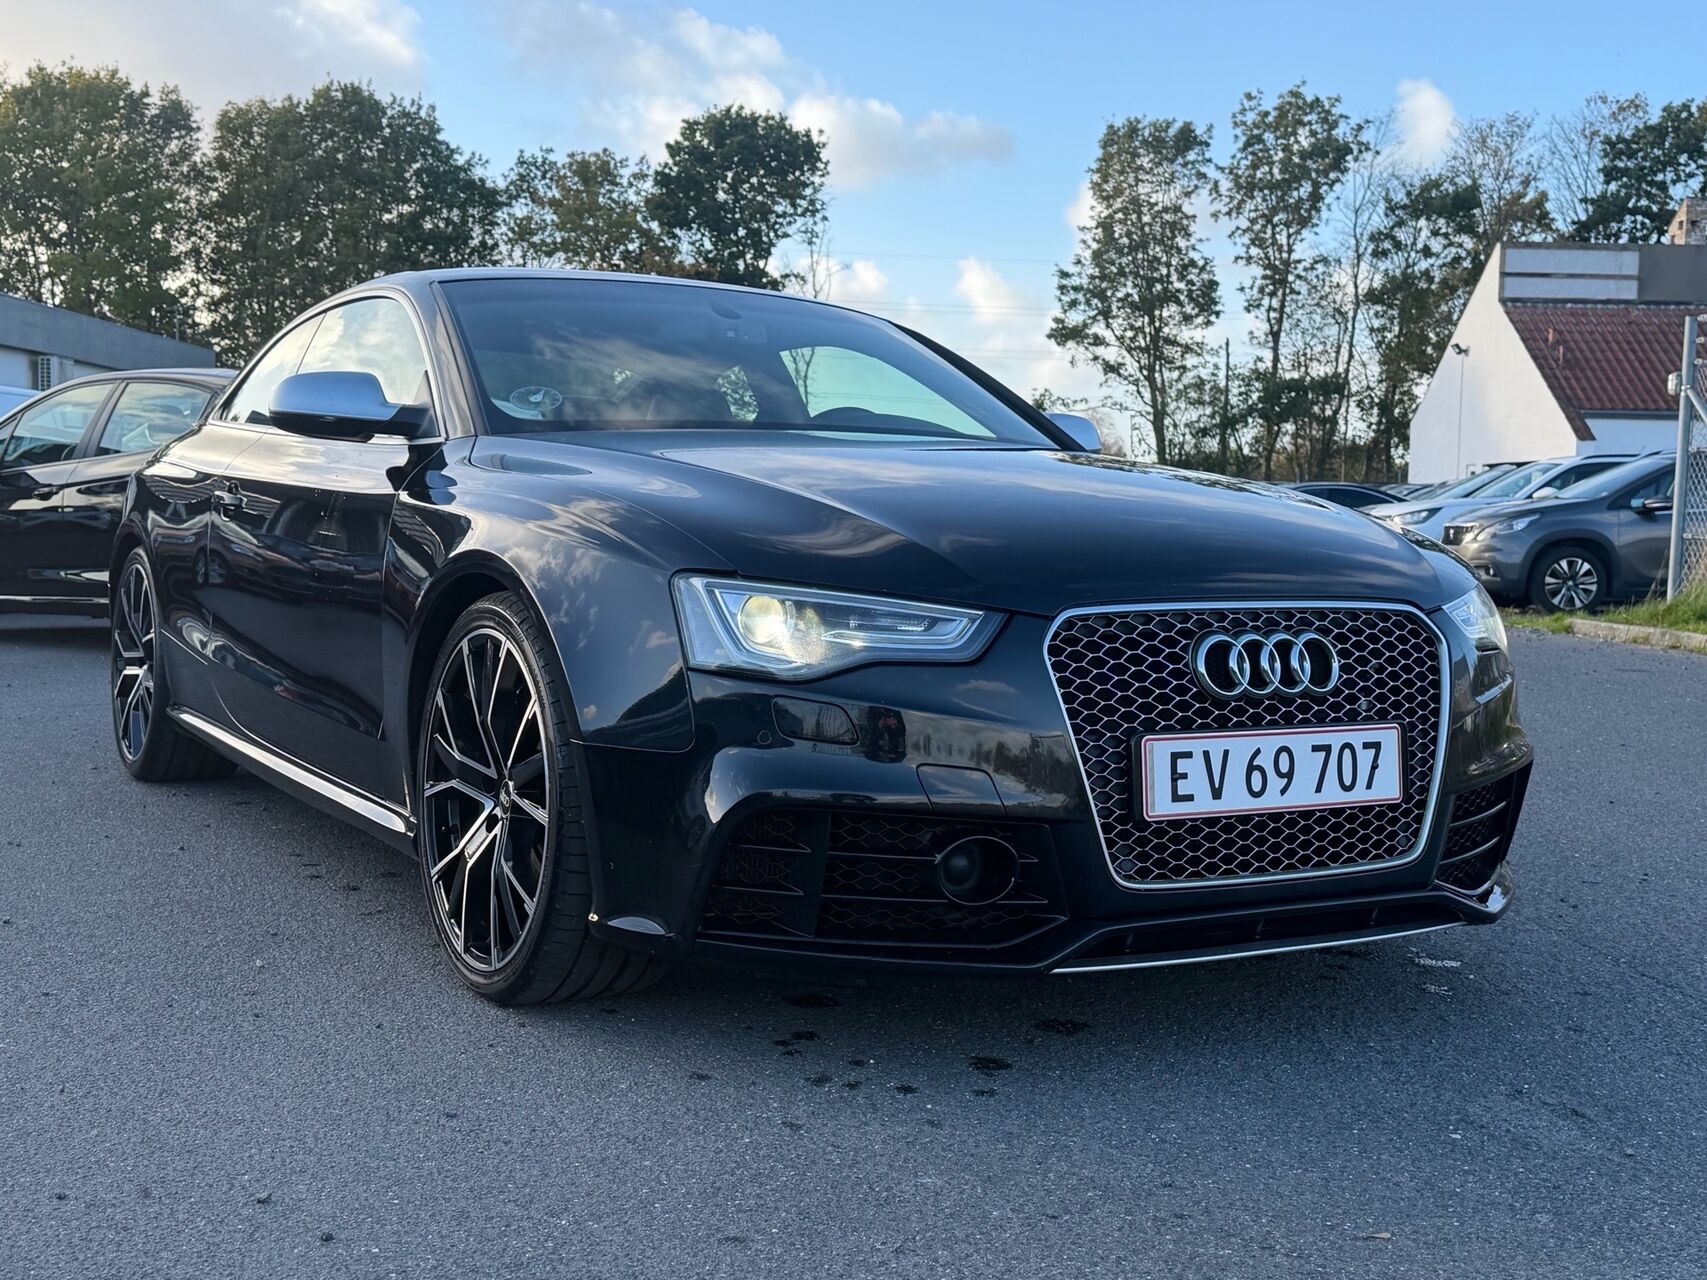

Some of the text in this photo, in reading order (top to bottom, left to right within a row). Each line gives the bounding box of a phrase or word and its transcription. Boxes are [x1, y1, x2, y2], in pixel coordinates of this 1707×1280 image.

[1170, 741, 1382, 803] EV 69 707
